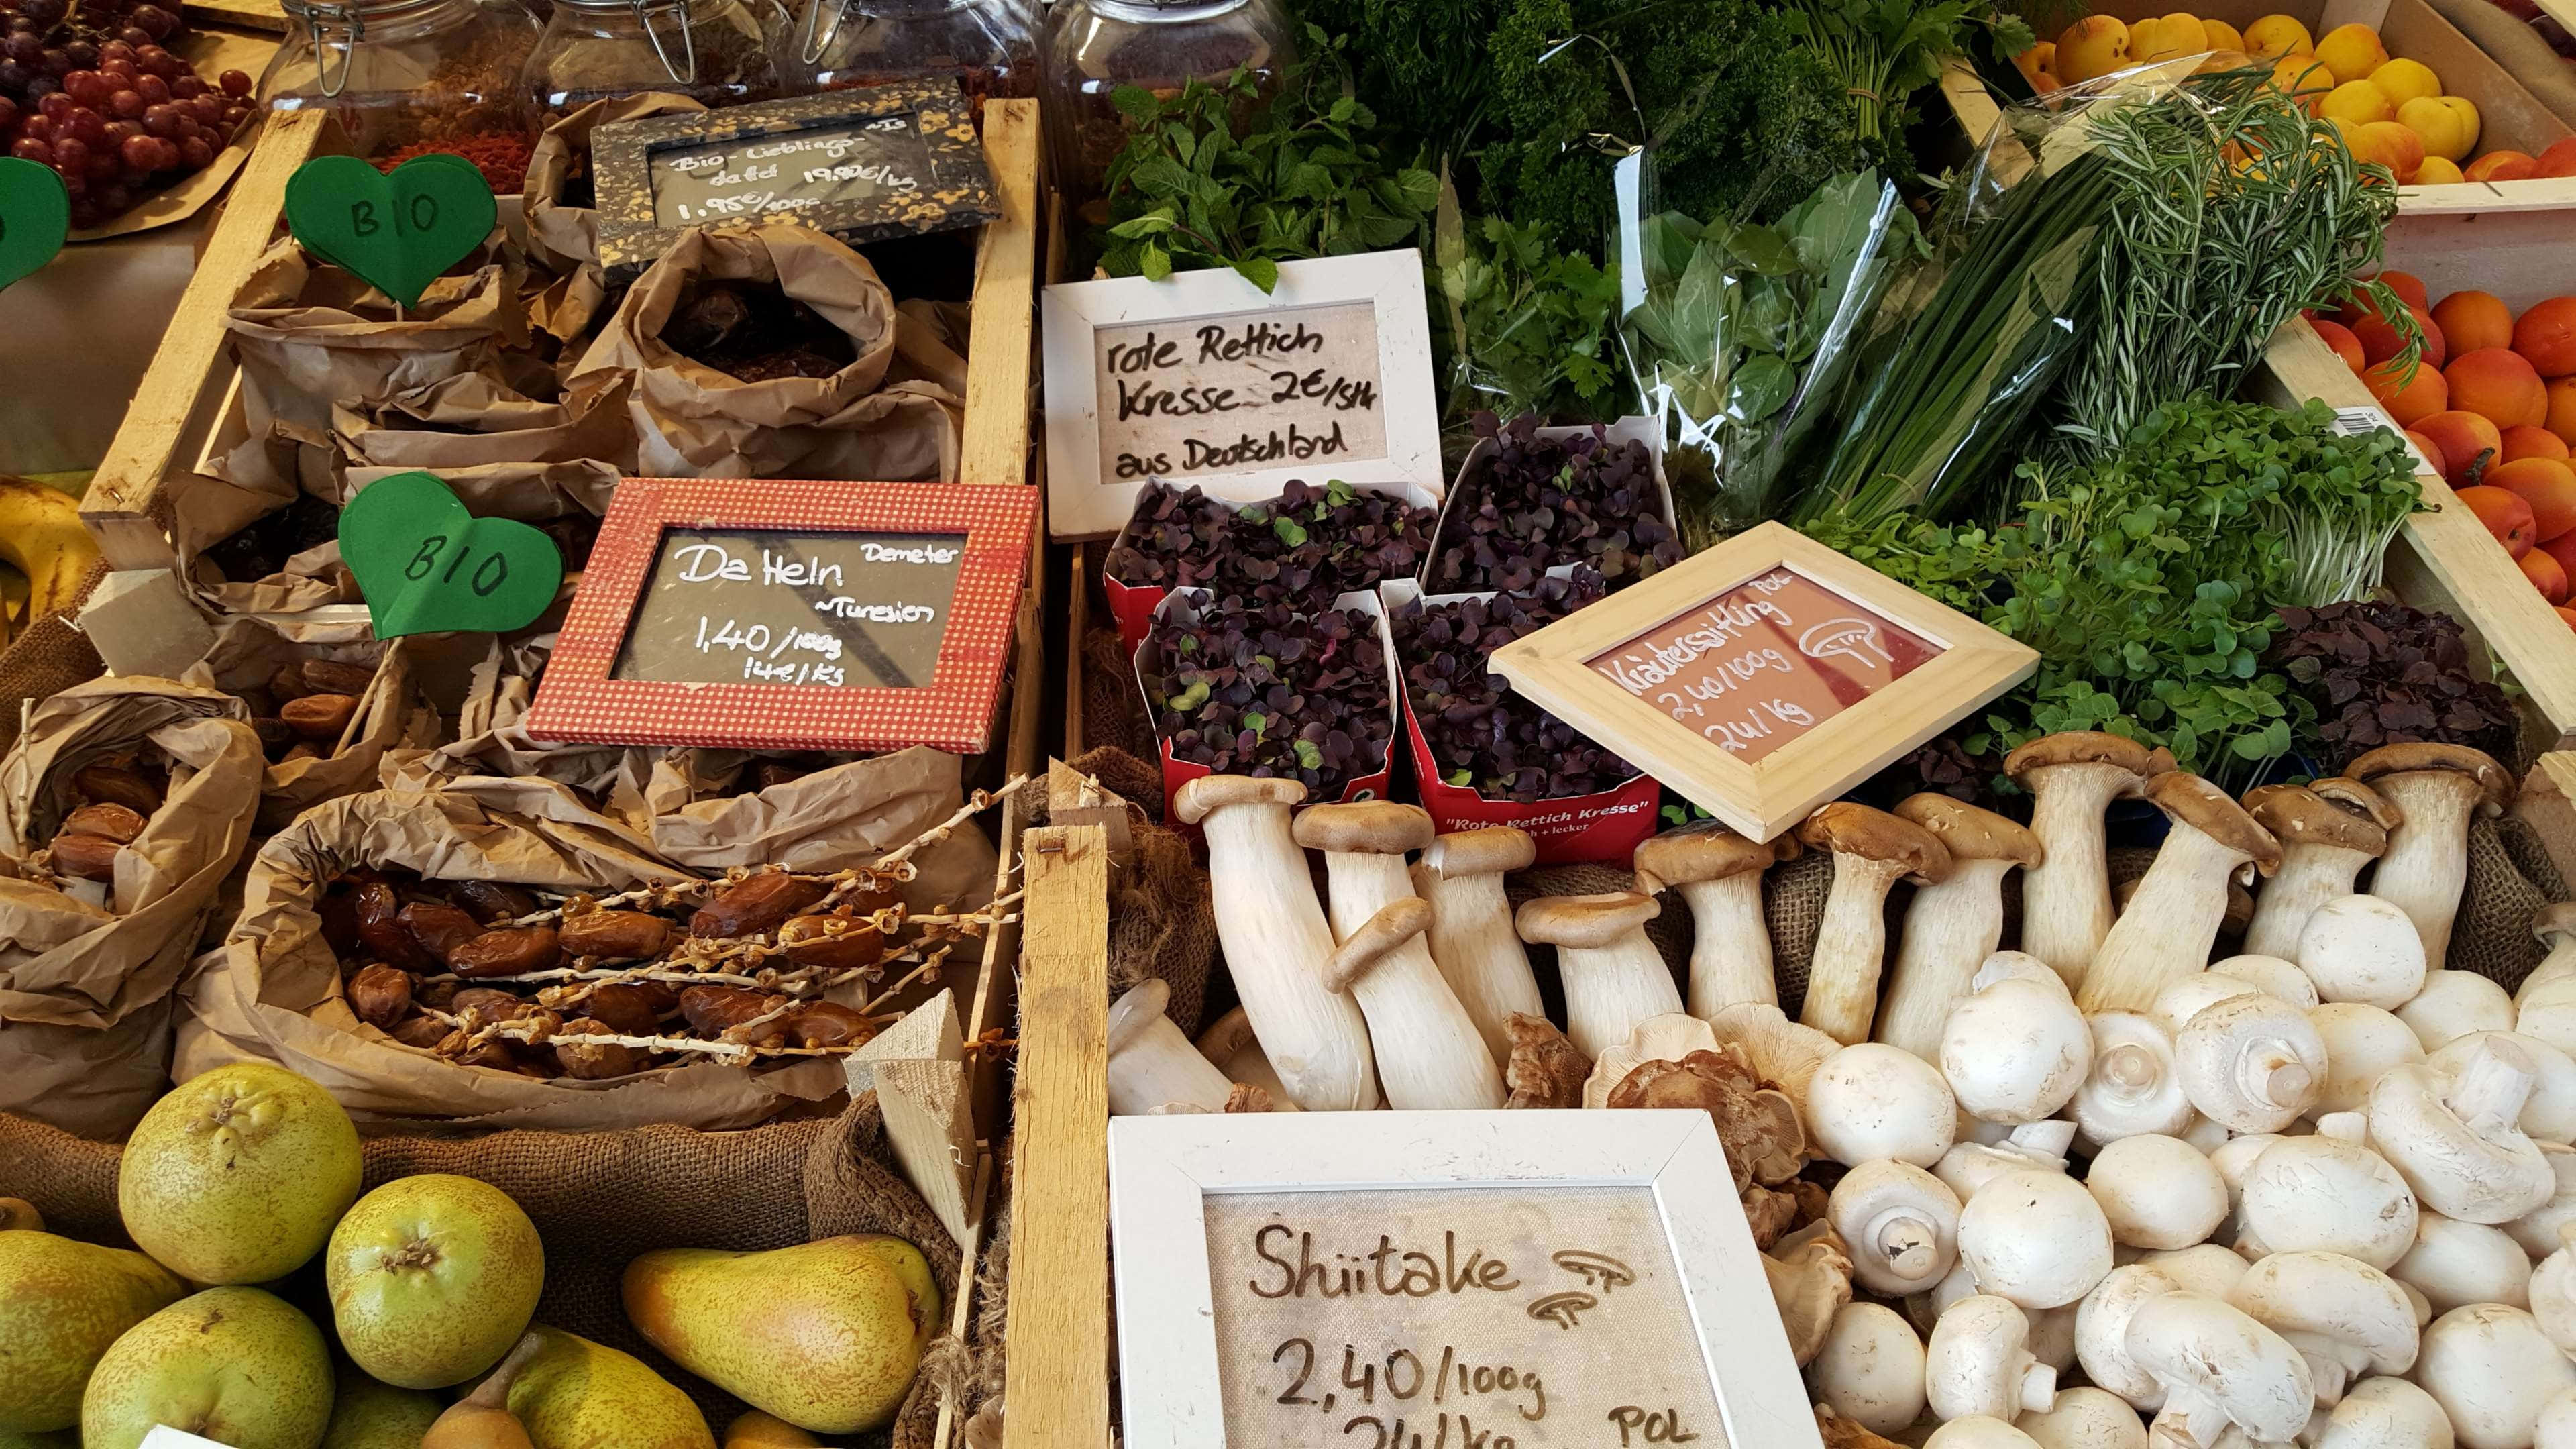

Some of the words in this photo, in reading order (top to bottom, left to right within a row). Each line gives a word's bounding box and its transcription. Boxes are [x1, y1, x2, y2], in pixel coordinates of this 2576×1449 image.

[351, 193, 439, 237] BIO
[1108, 331, 1183, 374] rote
[1195, 322, 1324, 364] Rettich
[1117, 378, 1240, 422] Kresse
[1115, 452, 1173, 478] aus
[1182, 421, 1348, 470] Deutschland
[404, 535, 508, 596] BIO
[860, 543, 959, 564] Demeter
[1748, 574, 1793, 596] POL
[695, 616, 843, 661] 1,40/100g
[1657, 648, 1794, 722] 2,40/100g
[1506, 812, 1572, 829] Rettich
[1578, 800, 1649, 820] Kresse"
[1552, 824, 1589, 835] lecker
[1250, 1224, 1521, 1299] Shiitake
[1273, 1338, 1546, 1421] 2,40/100g
[1608, 1405, 1701, 1448] POL
